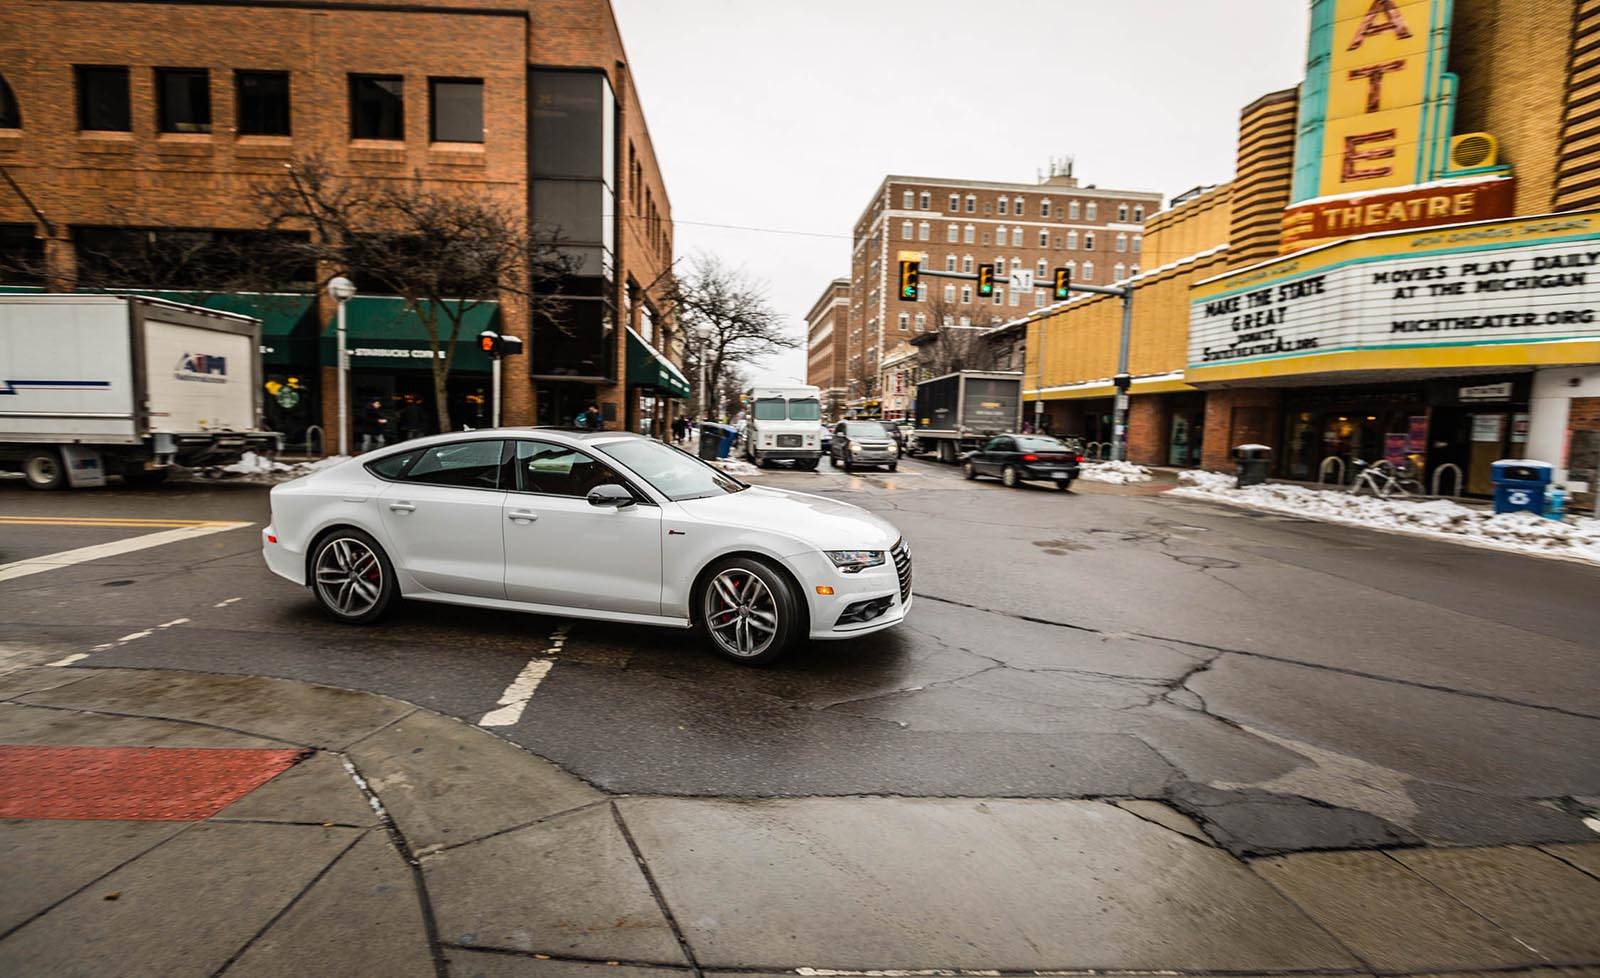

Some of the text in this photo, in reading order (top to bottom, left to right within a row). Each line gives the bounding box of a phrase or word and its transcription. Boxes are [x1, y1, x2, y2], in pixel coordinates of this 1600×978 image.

[1322, 192, 1475, 230] THEATRE
[1373, 251, 1600, 284] MOVIES PLAY DAILY
[1205, 296, 1239, 318] MAKE
[1240, 288, 1272, 309] THE
[1278, 274, 1326, 302] STATE
[1393, 272, 1586, 300] AT THE MICHIGAN
[1231, 306, 1287, 332] GREAT
[1391, 308, 1595, 333] MICHTHEATER.ORG
